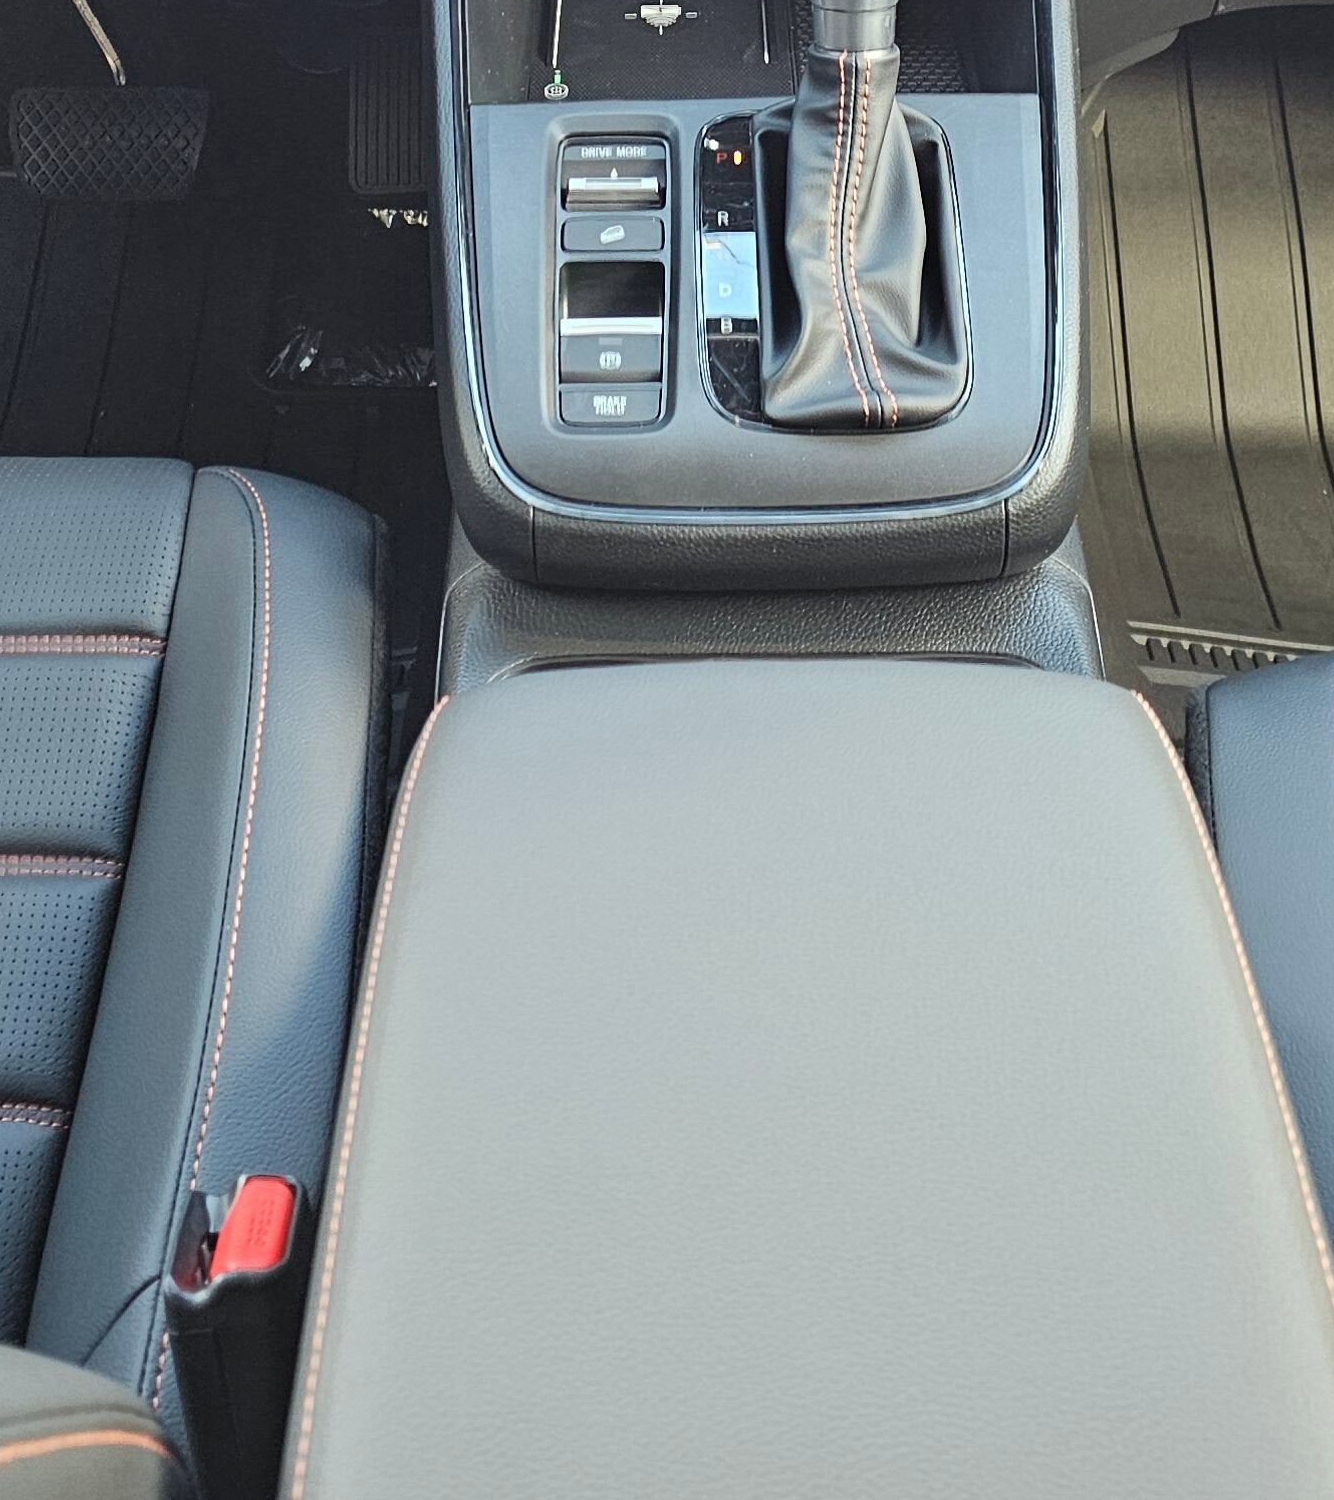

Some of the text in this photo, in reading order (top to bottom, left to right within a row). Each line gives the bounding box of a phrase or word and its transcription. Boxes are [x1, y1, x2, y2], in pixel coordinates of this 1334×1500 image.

[581, 146, 647, 158] DRIVE MODE
[716, 152, 728, 164] P
[718, 211, 729, 227] R
[719, 283, 732, 297] D
